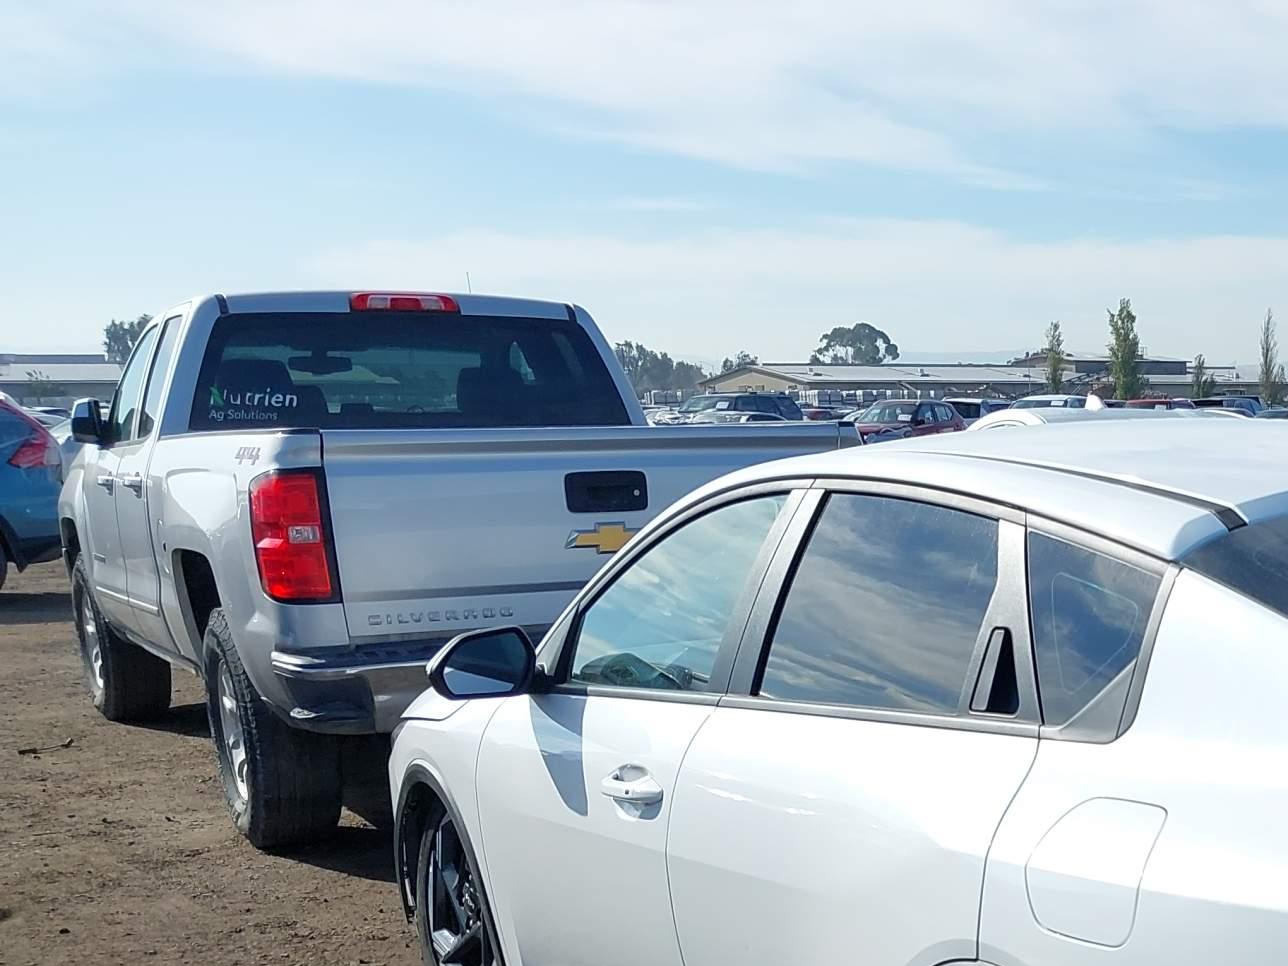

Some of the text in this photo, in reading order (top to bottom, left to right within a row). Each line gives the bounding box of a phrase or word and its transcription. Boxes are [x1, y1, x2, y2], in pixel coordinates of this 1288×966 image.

[209, 386, 298, 408] Nutrien
[209, 410, 278, 422] Ag Solutions
